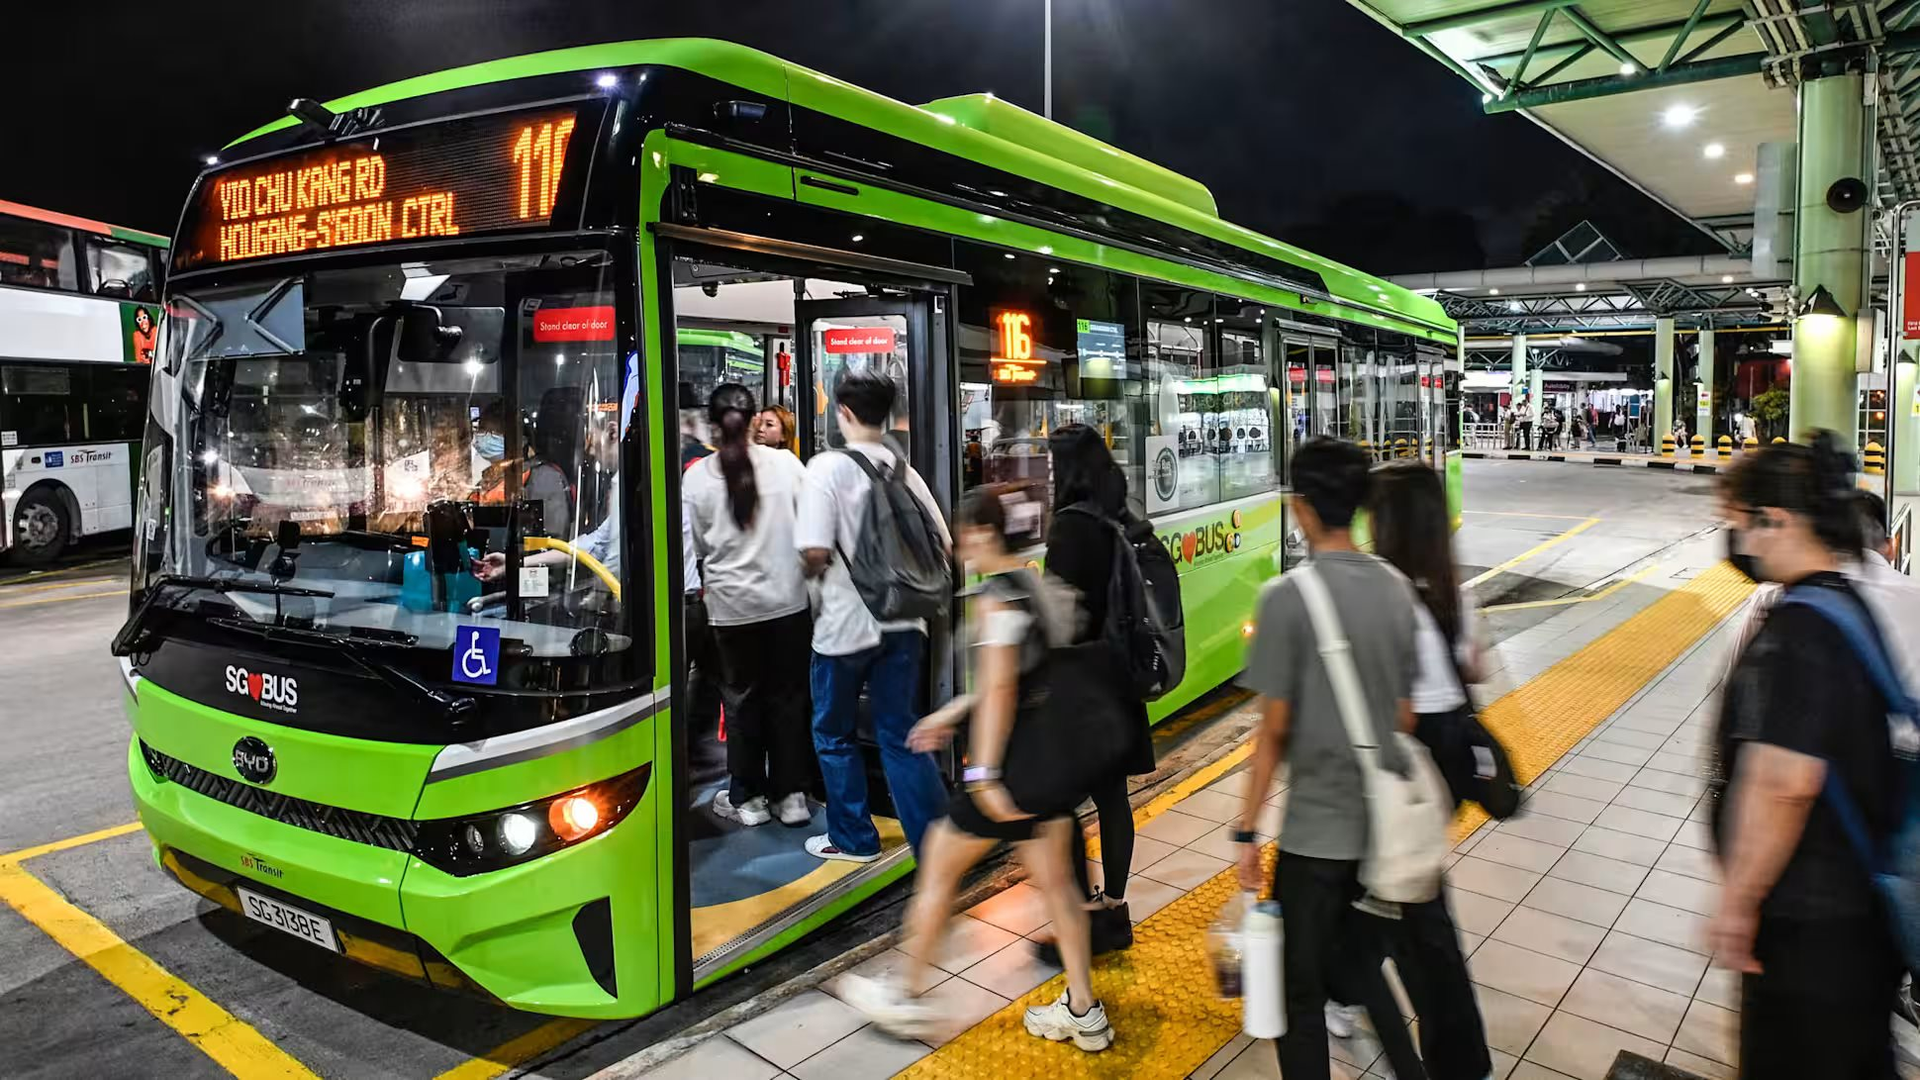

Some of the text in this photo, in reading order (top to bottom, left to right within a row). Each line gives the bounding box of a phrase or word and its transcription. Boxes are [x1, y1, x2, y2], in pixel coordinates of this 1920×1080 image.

[221, 155, 386, 220] YIO CHU KANG RD
[402, 192, 460, 238] CTRL
[540, 319, 608, 331] Stand clear of door
[1002, 312, 1030, 359] 116
[849, 337, 863, 345] clear
[865, 336, 872, 344] of
[873, 336, 888, 344] door
[70, 454, 84, 464] SBS
[78, 449, 112, 462] Transit
[1195, 521, 1224, 557] BUS
[225, 664, 298, 706] SG BUS
[234, 751, 269, 773] BYD
[241, 856, 284, 879] SBS Transit
